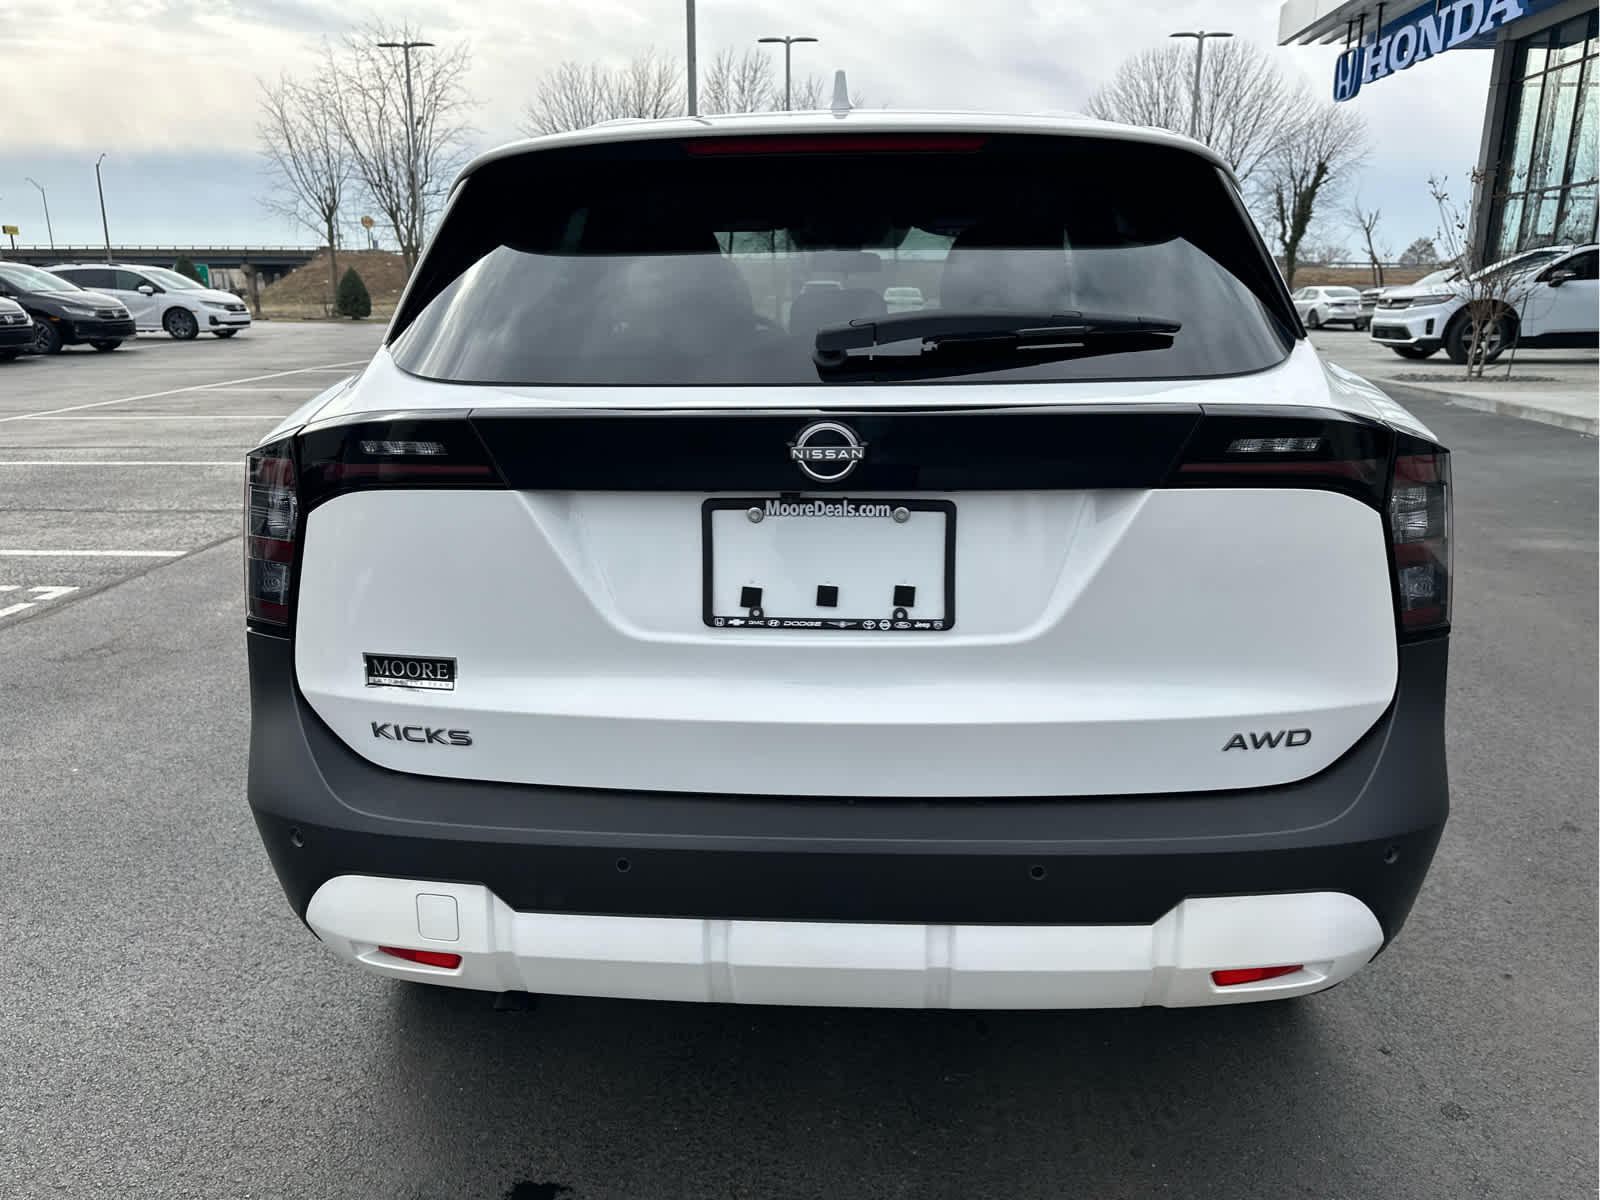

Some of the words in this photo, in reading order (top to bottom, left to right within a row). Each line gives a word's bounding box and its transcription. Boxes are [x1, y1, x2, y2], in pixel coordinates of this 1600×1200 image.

[1362, 0, 1523, 84] HONDA
[792, 449, 863, 459] NISSAN
[765, 500, 891, 517] MooreDeals.com
[372, 659, 449, 679] MOORE
[371, 721, 472, 746] KICKS
[1222, 728, 1312, 751] AWD
